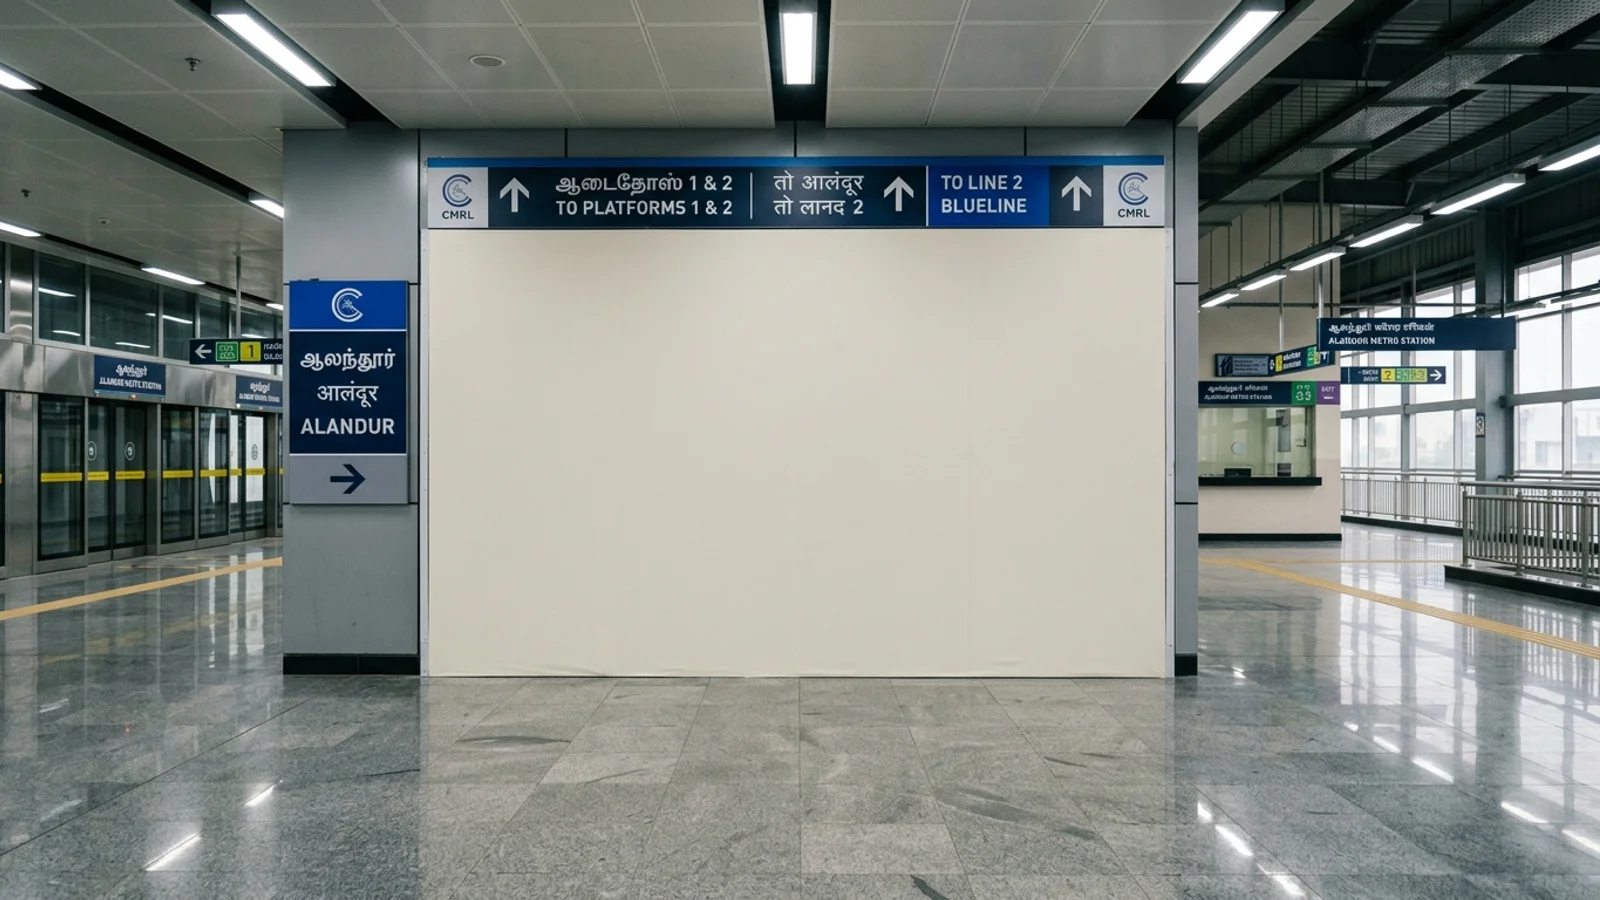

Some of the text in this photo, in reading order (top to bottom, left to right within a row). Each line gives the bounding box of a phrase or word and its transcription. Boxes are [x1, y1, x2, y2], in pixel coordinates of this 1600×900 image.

[690, 175, 697, 191] 1
[704, 175, 717, 191] &
[722, 175, 733, 191] 2
[773, 170, 865, 196] तो आलंदूर
[941, 174, 1023, 190] TO LINE 2
[555, 200, 733, 215] TO PLATFORMS 1 & 2
[773, 195, 864, 216] तो लानद 2
[941, 198, 1027, 214] BLUELINE
[1117, 208, 1151, 218] CMRL
[441, 210, 475, 220] CMRL
[1400, 336, 1436, 345] STATION
[248, 344, 254, 358] 1
[300, 347, 396, 373] ஆலந்தூர்
[316, 380, 380, 408] आलंदूर
[300, 417, 395, 435] ALANDUR
